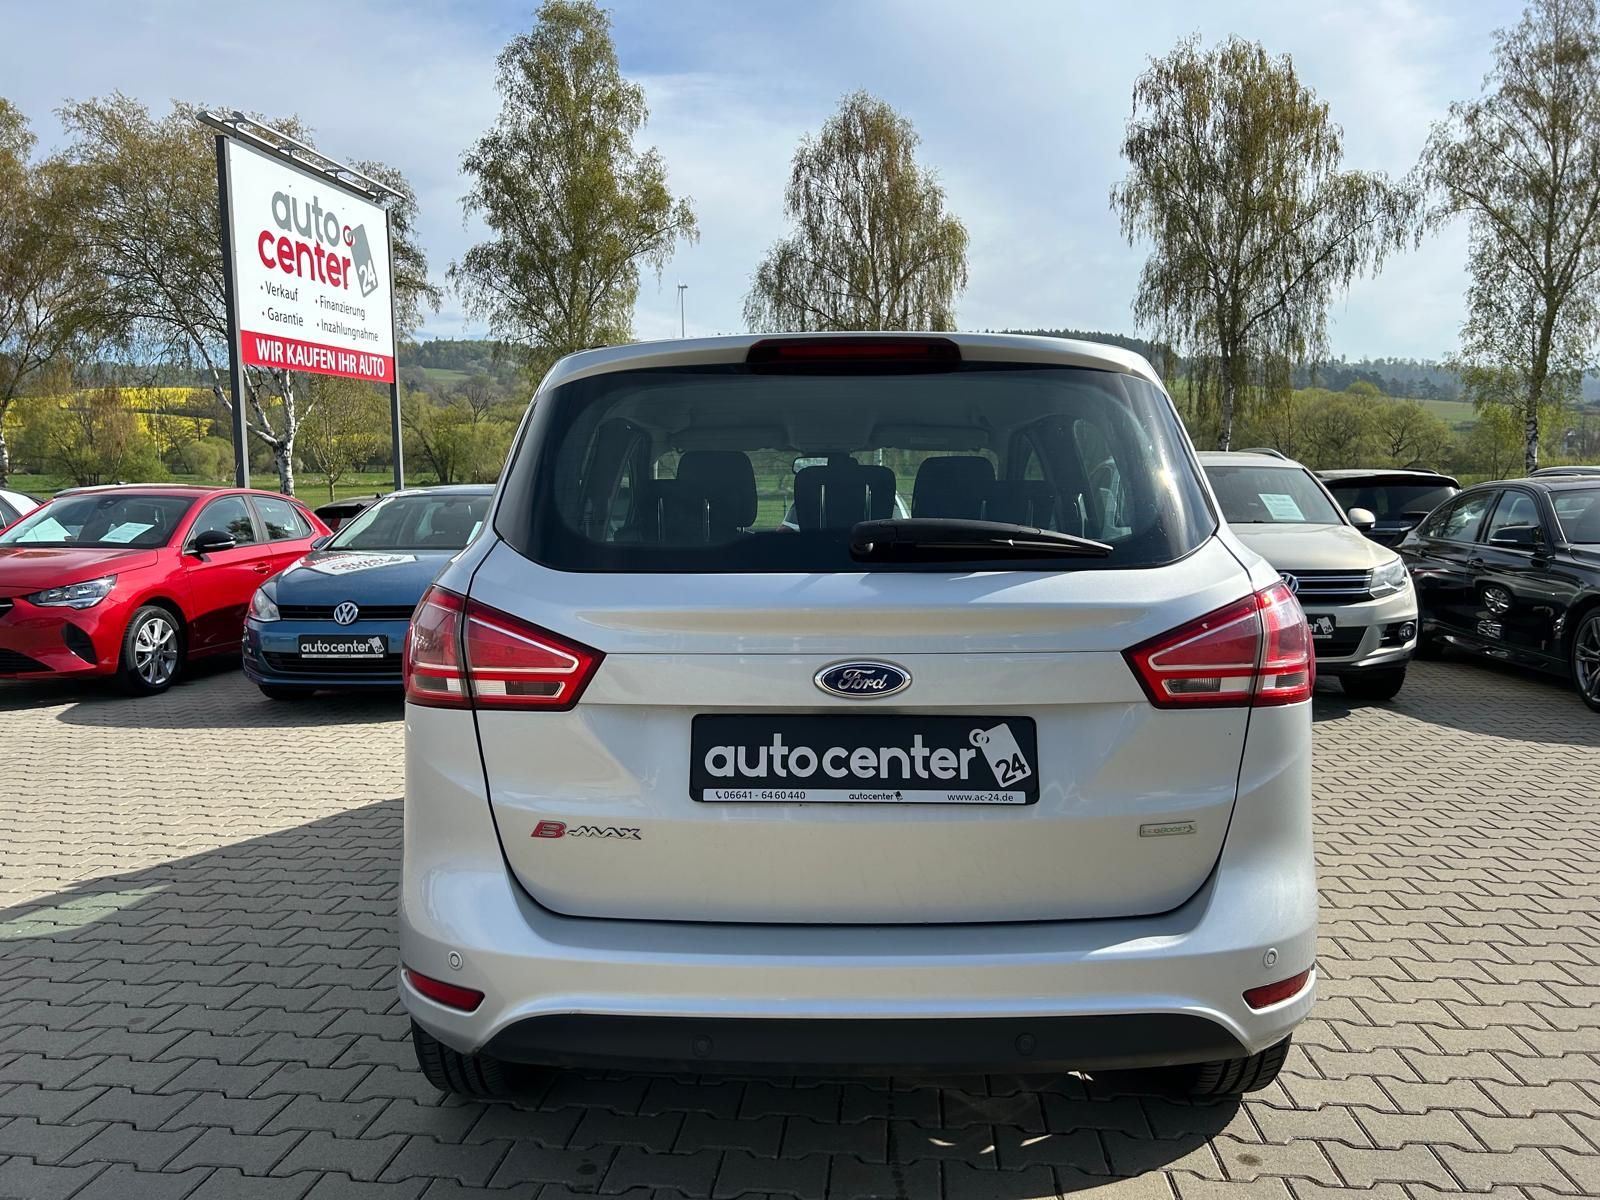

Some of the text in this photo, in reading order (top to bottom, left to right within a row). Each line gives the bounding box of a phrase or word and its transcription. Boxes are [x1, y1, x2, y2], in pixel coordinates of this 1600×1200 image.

[272, 191, 340, 247] auto
[258, 230, 351, 289] center
[358, 261, 377, 291] 24
[265, 281, 299, 302] Verkauf
[267, 307, 304, 327] Garantie
[319, 295, 366, 321] Finanzierung
[321, 320, 379, 342] Inzahlungnahme
[255, 338, 385, 377] WIR KAUFEN IHR AUTO
[301, 640, 370, 653] autocenter
[838, 669, 888, 690] Ford
[704, 733, 976, 780] autocenter
[994, 752, 1026, 784] 24
[723, 791, 753, 800] 06641
[848, 792, 894, 801] autocenter
[947, 793, 1013, 803] www.ac-24.de
